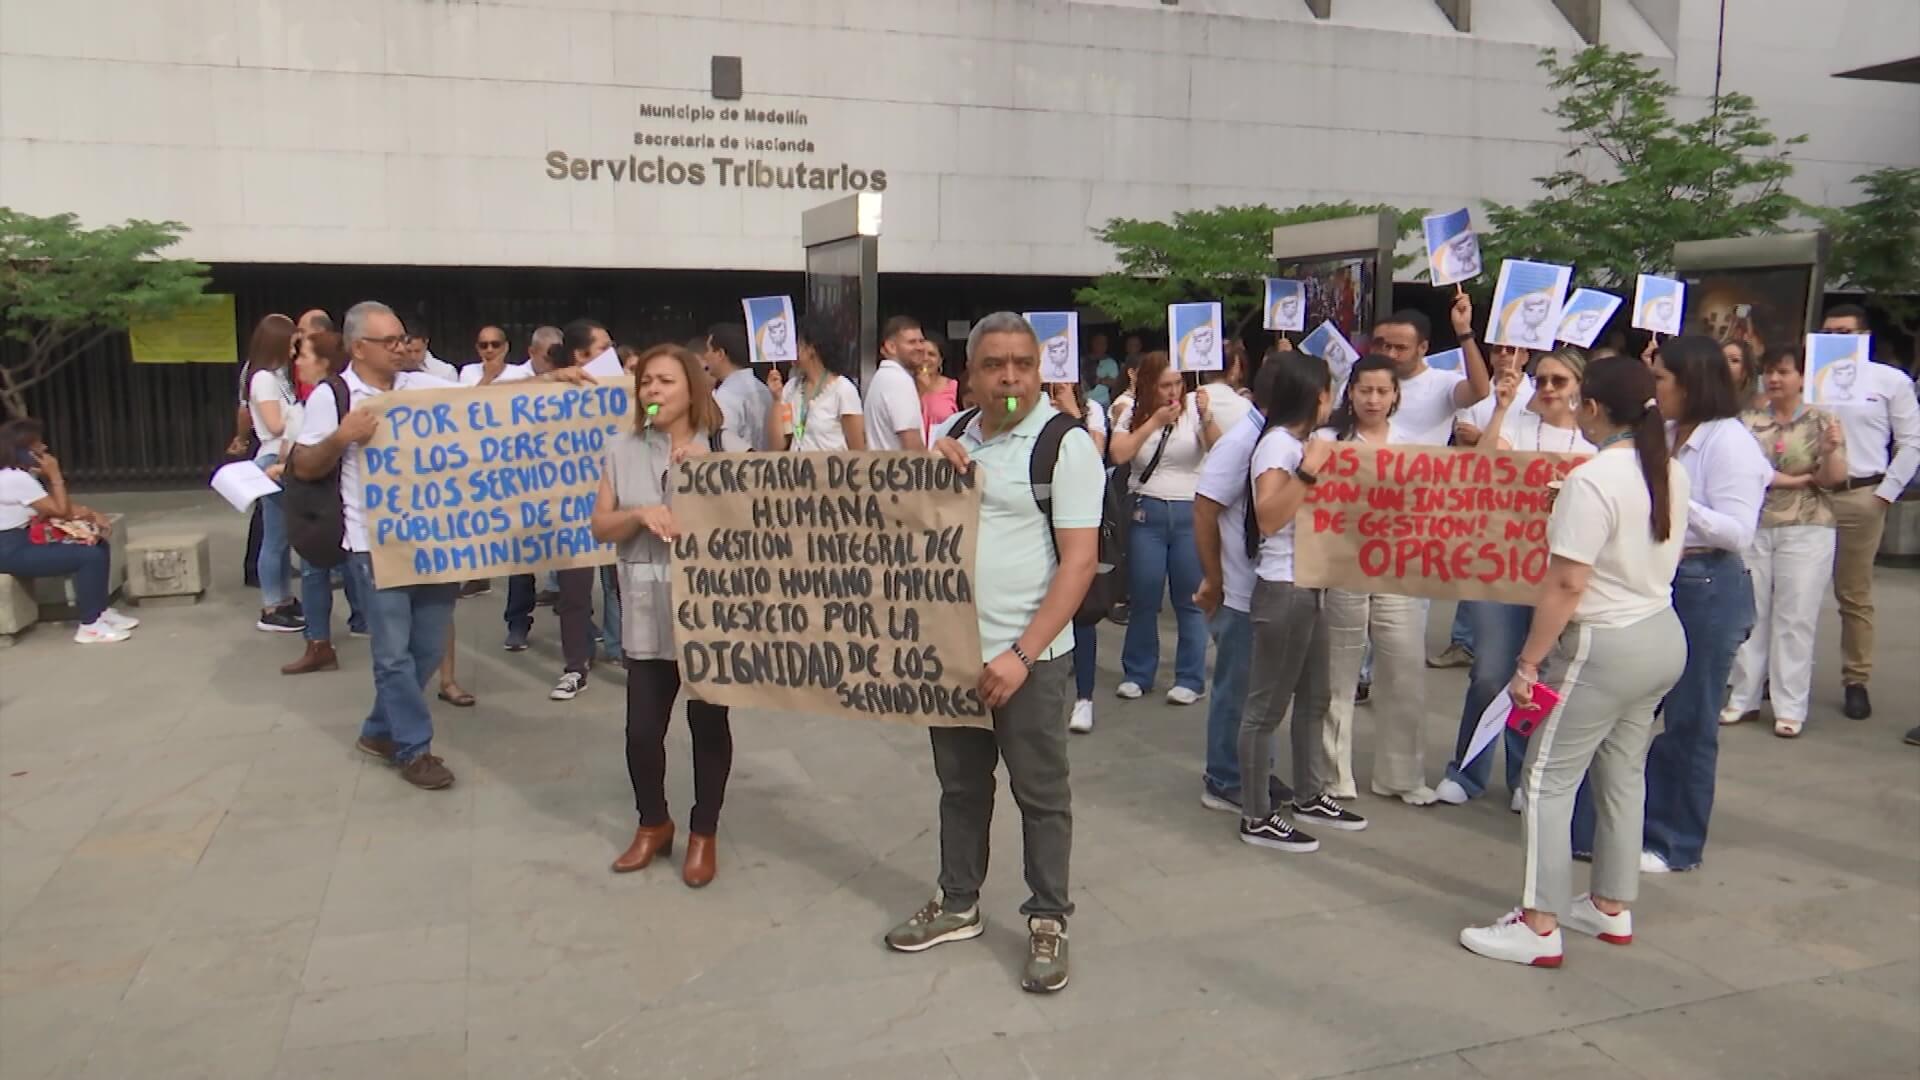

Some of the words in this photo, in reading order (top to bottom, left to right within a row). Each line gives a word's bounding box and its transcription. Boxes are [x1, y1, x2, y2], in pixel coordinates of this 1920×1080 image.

[640, 104, 715, 123] Municipio
[720, 107, 739, 120] de
[720, 136, 739, 149] de
[745, 137, 815, 152] Hacienda
[545, 151, 706, 186] Servicios
[712, 157, 887, 191] Tributarios
[385, 404, 458, 439] POR
[467, 402, 502, 431] EL
[511, 387, 628, 425] RESPETO
[365, 447, 401, 475] DE
[414, 442, 469, 475] LOS
[678, 457, 817, 495] SECRETARIA
[827, 455, 861, 492] DE
[1376, 448, 1517, 486] PLANTAS
[365, 484, 402, 514] DE
[411, 477, 462, 510] LOS
[1367, 487, 1405, 511] UN
[1411, 487, 1549, 514] INSTRUME
[377, 507, 511, 545] PÚBLICOS
[521, 500, 552, 528] DE
[1313, 508, 1345, 533] DE
[1358, 512, 1489, 541] GESTION!
[673, 532, 699, 560] LA
[807, 531, 918, 567] INTEGRAL
[923, 524, 963, 565] DEL
[1358, 538, 1549, 585] OPRESIO
[683, 566, 771, 598] TALENTO
[779, 566, 872, 599] HUMANO
[883, 567, 971, 603] IMPLICA
[678, 601, 706, 630] EL
[712, 602, 809, 634] RESPETO
[824, 602, 880, 639] POR
[889, 606, 920, 642] LA
[684, 640, 843, 689] DIGNIDAD
[850, 642, 880, 678] DE
[893, 645, 943, 682] LOS
[837, 681, 986, 719] SERVIDORES
